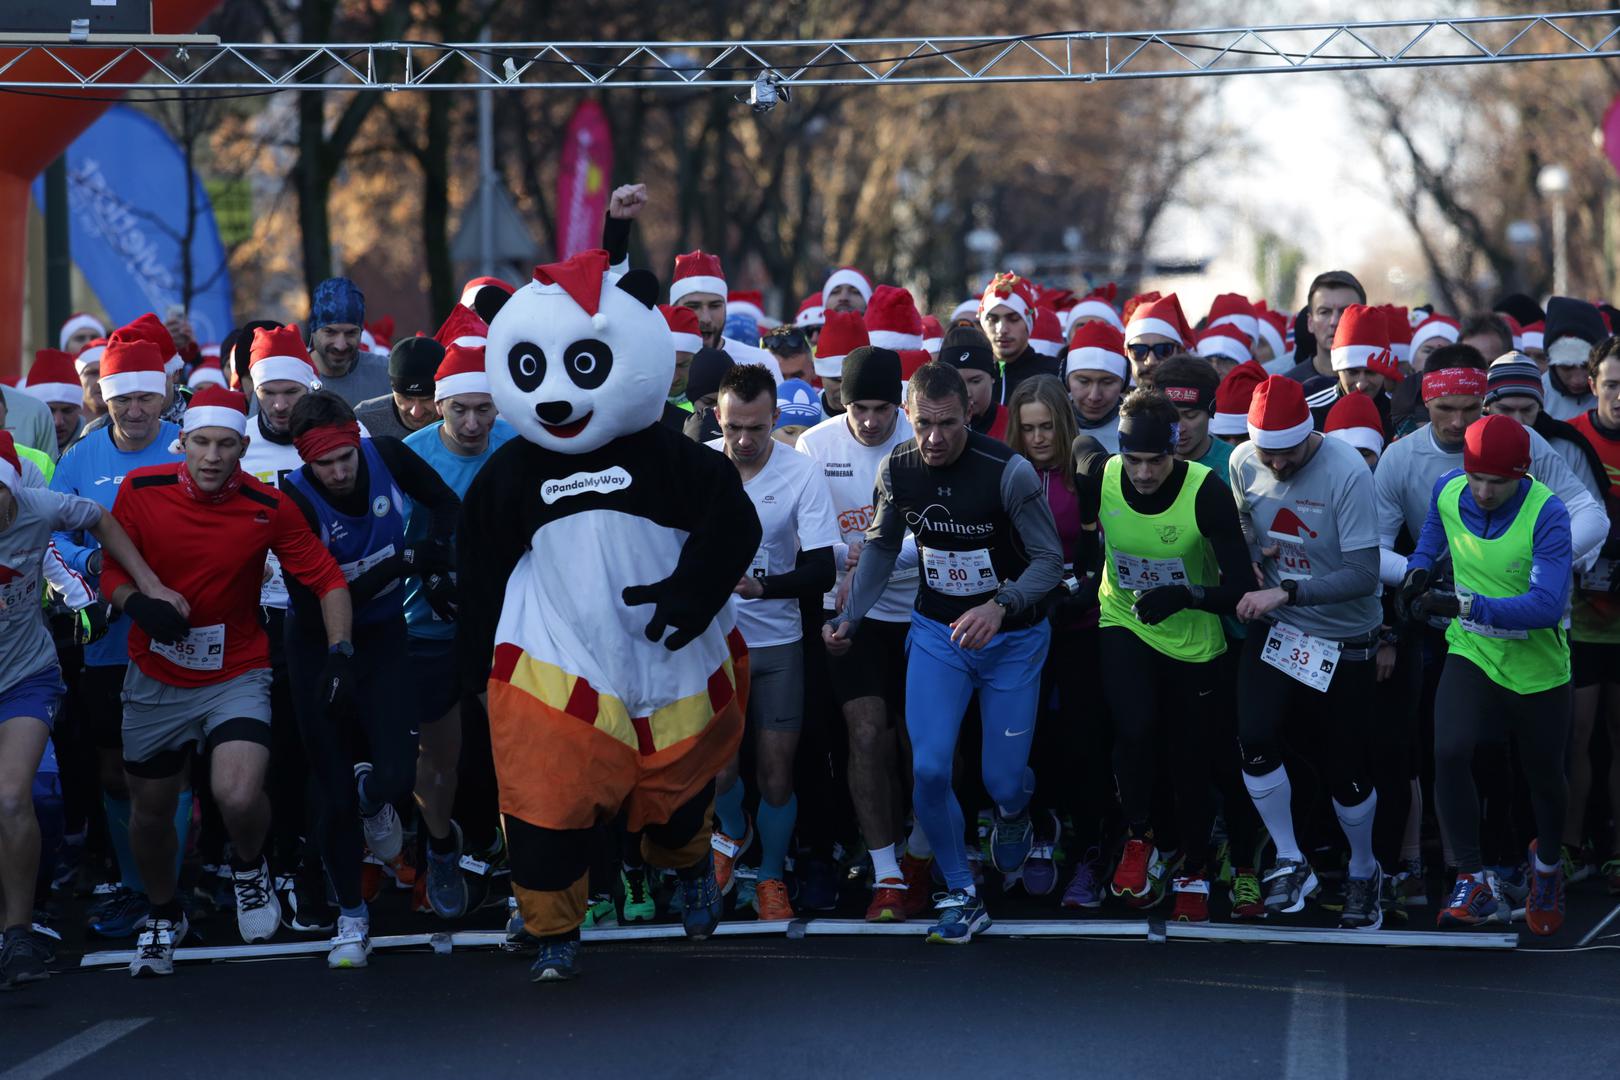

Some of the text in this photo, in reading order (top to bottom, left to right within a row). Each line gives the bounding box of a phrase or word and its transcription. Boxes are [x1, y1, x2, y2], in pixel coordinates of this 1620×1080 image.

[545, 475, 625, 496] @PandaMyWay
[910, 510, 994, 537] Aminess
[948, 568, 968, 580] 80
[1140, 571, 1160, 581] 45
[1290, 648, 1310, 665] 33
